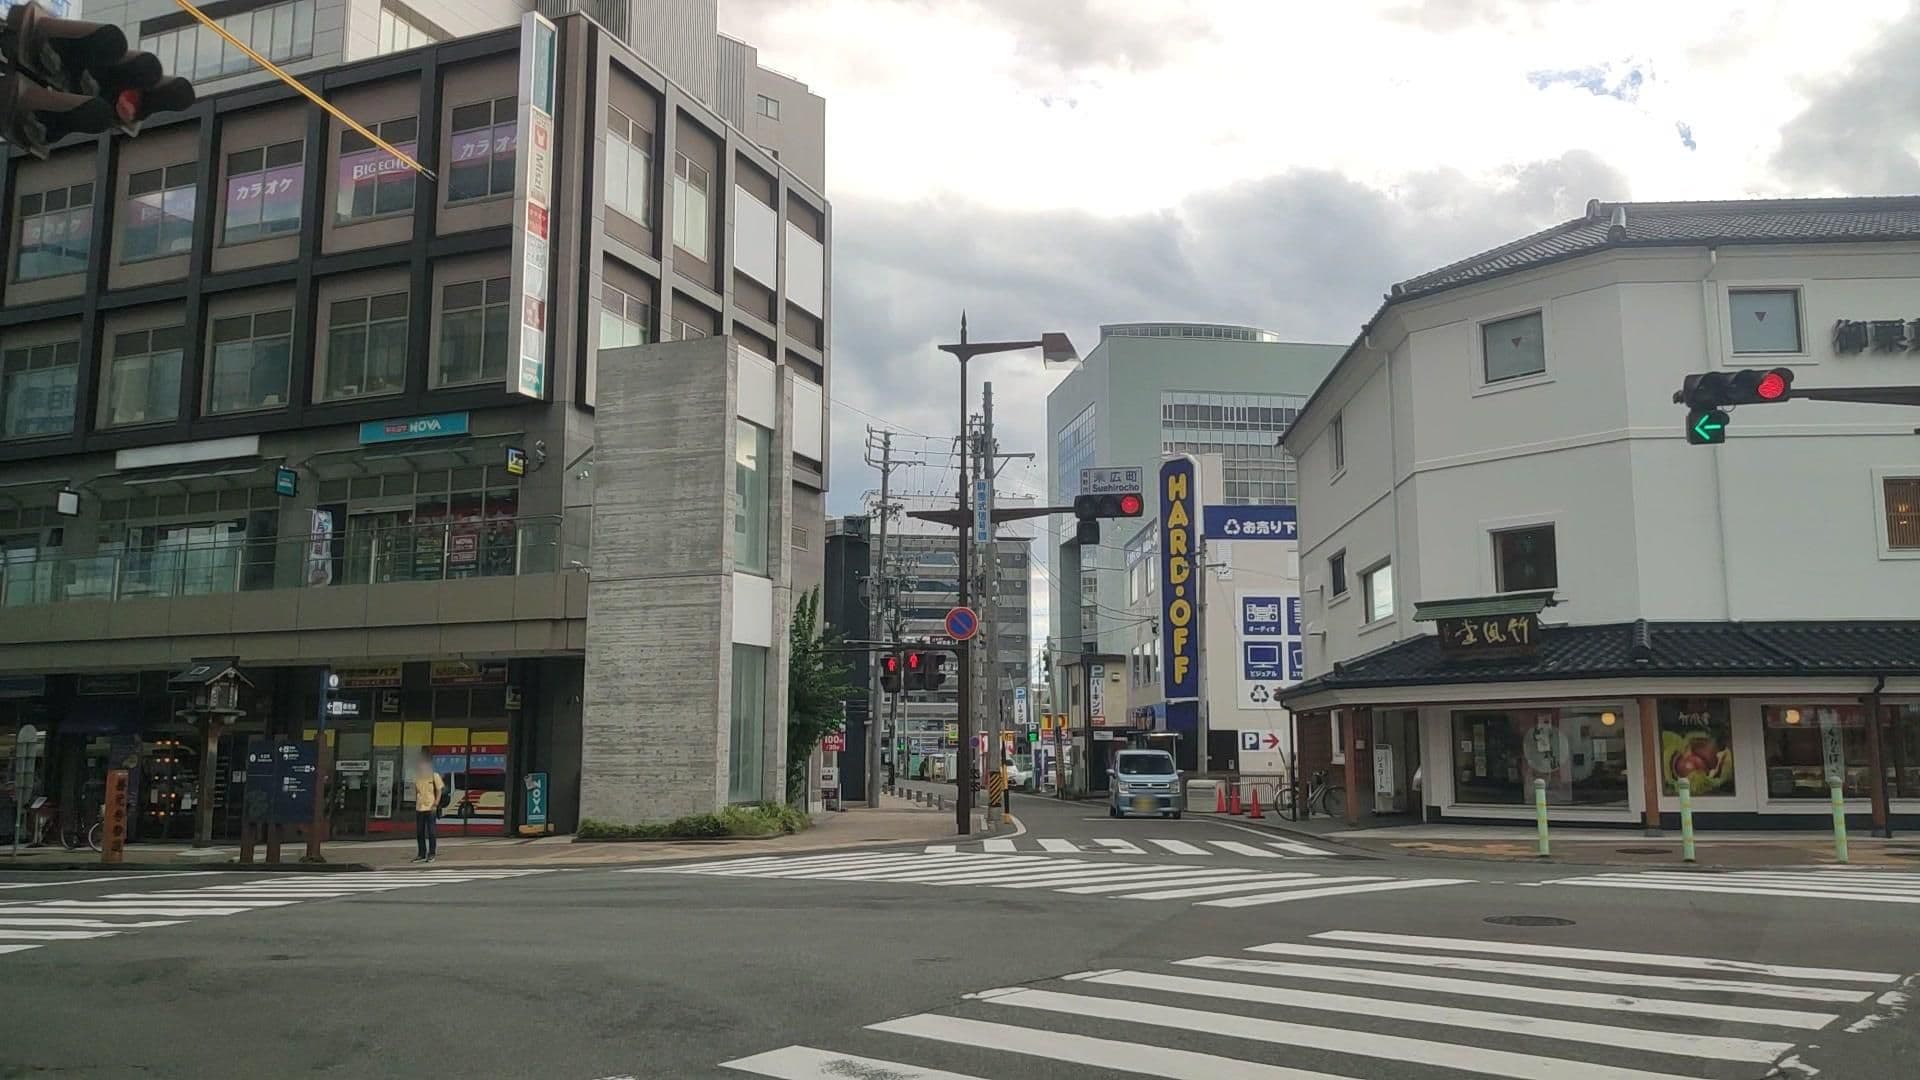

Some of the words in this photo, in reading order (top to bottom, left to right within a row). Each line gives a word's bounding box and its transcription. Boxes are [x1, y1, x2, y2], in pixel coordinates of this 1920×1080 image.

[461, 136, 516, 159] カラオ
[353, 162, 376, 180] BIG
[236, 178, 293, 201] カラオケ
[409, 419, 441, 433] NOVA
[1092, 483, 1140, 492] Suehirocho
[1242, 520, 1297, 535] お売り下
[1091, 665, 1104, 677] P
[1015, 688, 1025, 699] P
[1091, 679, 1100, 716] パーキング
[1244, 732, 1258, 749] P
